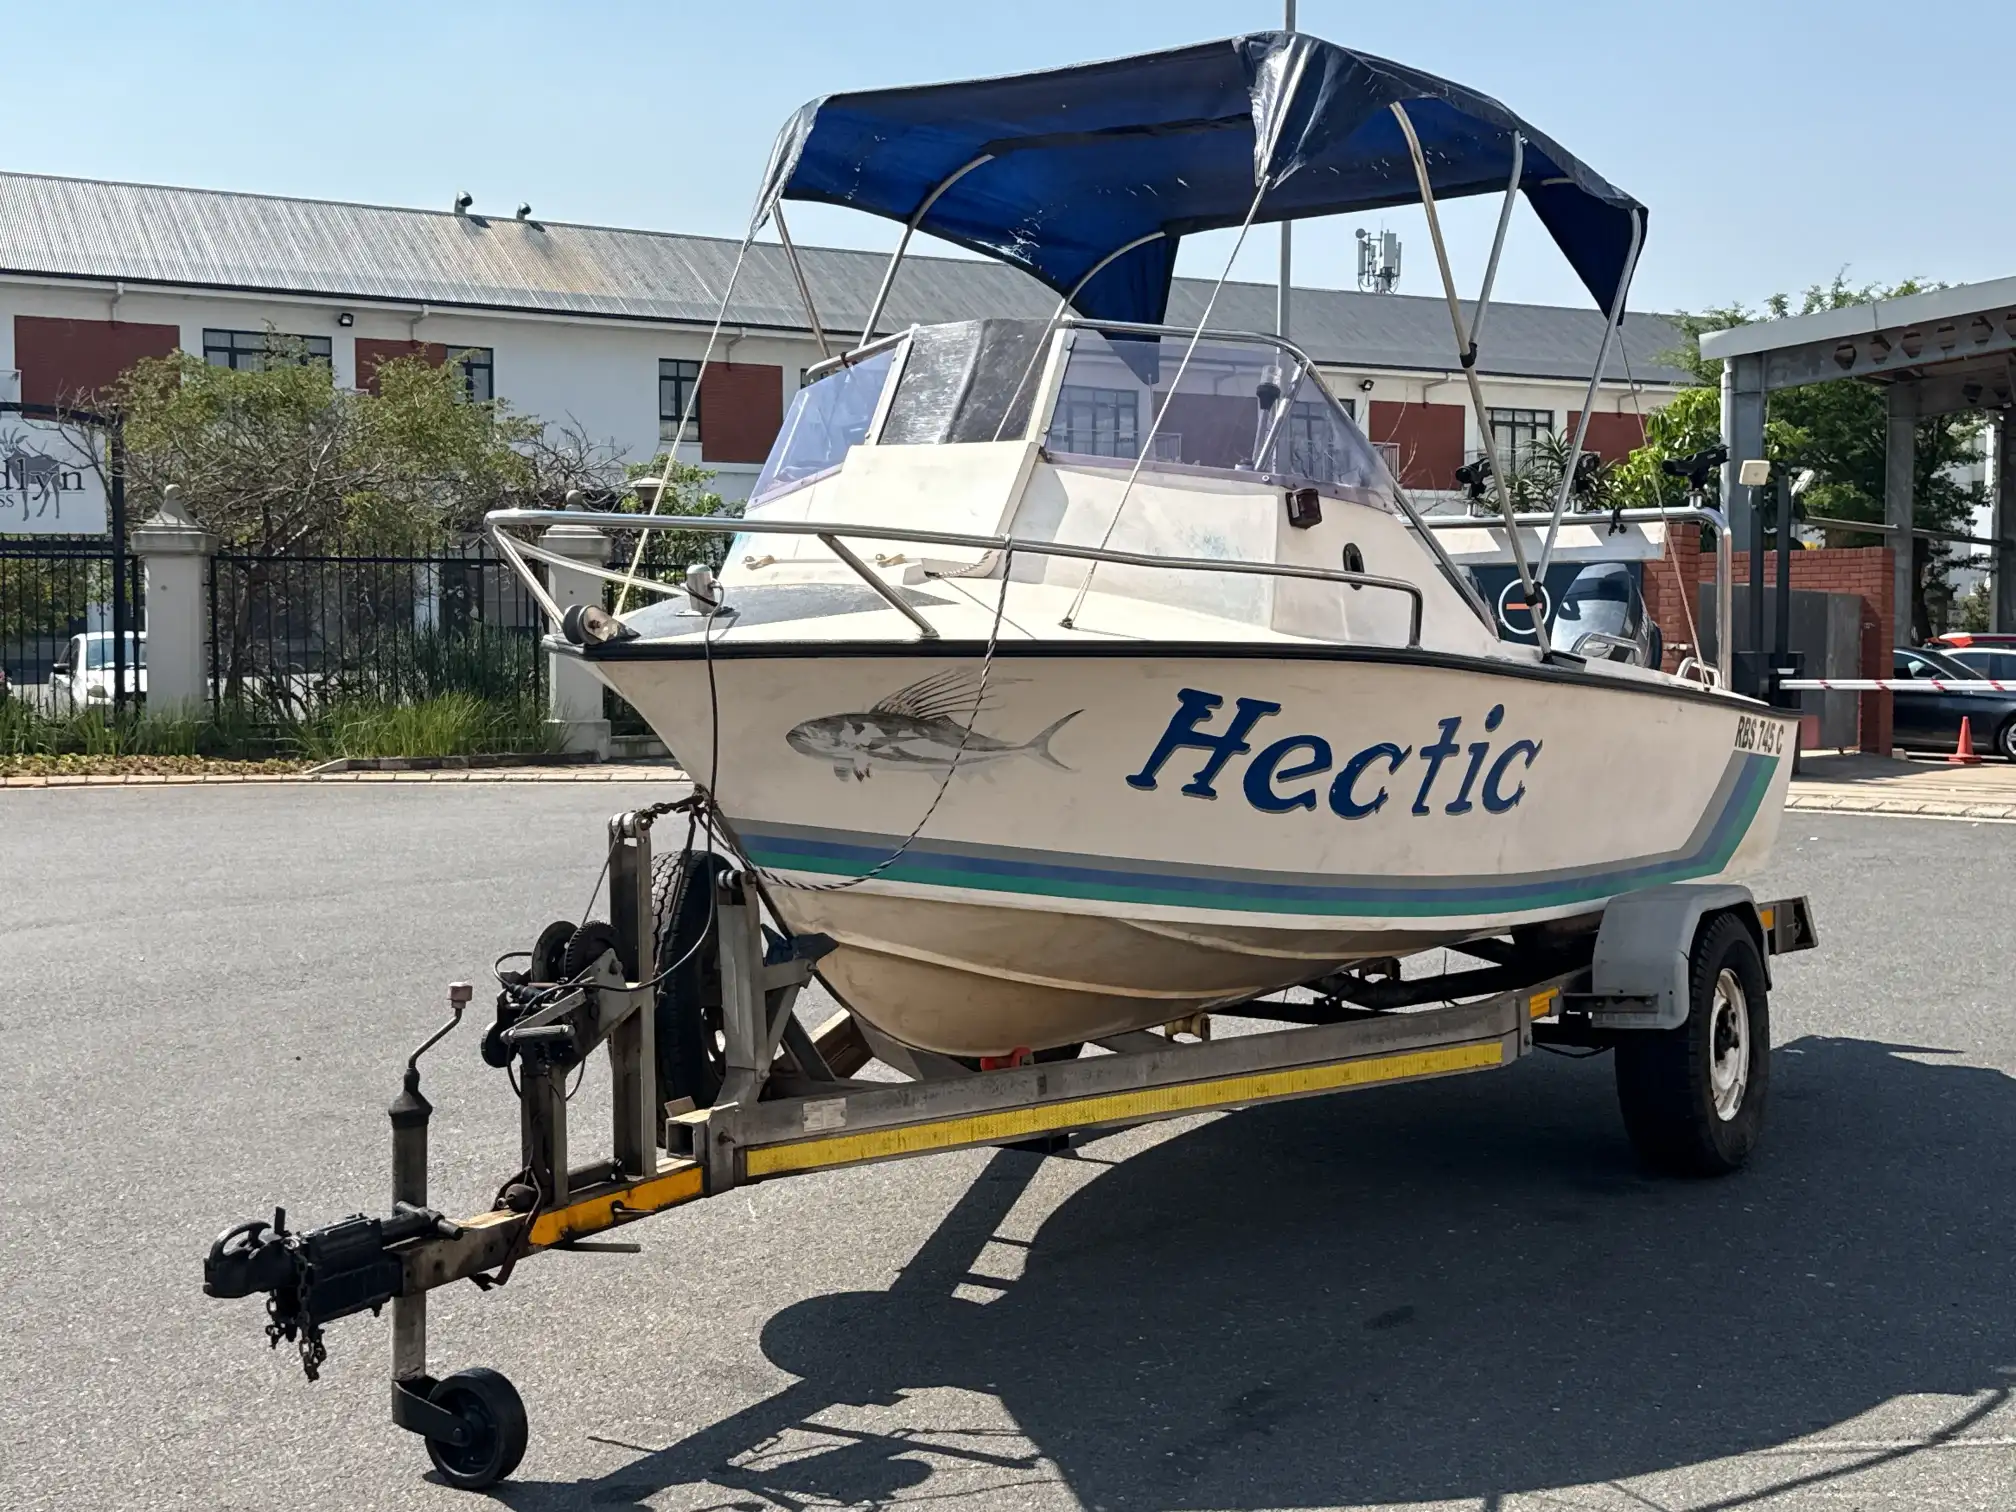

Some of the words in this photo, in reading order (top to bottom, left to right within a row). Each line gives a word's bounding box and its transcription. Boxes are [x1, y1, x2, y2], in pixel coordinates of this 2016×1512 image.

[1125, 687, 1543, 820] Hectic
[1734, 715, 1757, 750] RBS
[1757, 720, 1776, 753] 745
[1776, 724, 1785, 754] C
